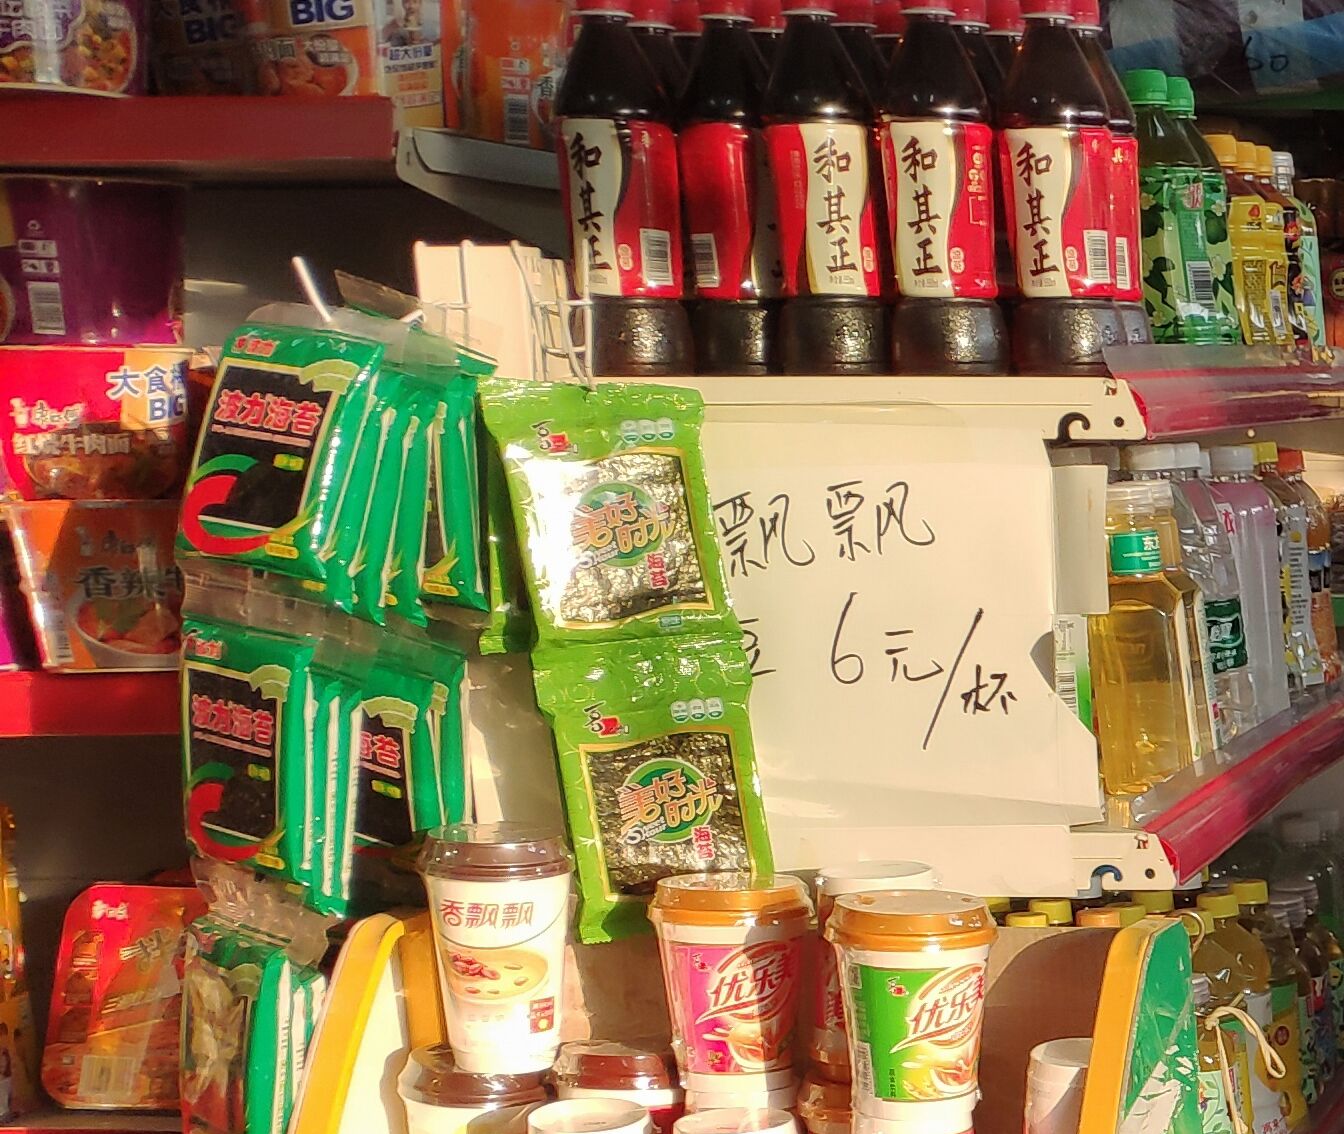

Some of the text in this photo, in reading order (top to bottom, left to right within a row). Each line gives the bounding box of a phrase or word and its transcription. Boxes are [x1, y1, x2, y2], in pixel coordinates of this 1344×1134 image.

[291, 0, 354, 26] BIG
[569, 131, 612, 271] 和其正
[813, 136, 858, 273] 和其正
[901, 135, 943, 276] 和其正
[1016, 140, 1061, 277] 和其正
[213, 389, 323, 436] 波力海苔
[572, 490, 676, 555] 美好时光
[712, 480, 936, 578] 飘飘
[191, 694, 274, 745] 波力海苔
[615, 767, 723, 829] 美好时光
[439, 898, 534, 930] 香飘飘
[709, 950, 794, 1008] 优乐美
[905, 973, 985, 1036] 优乐美
